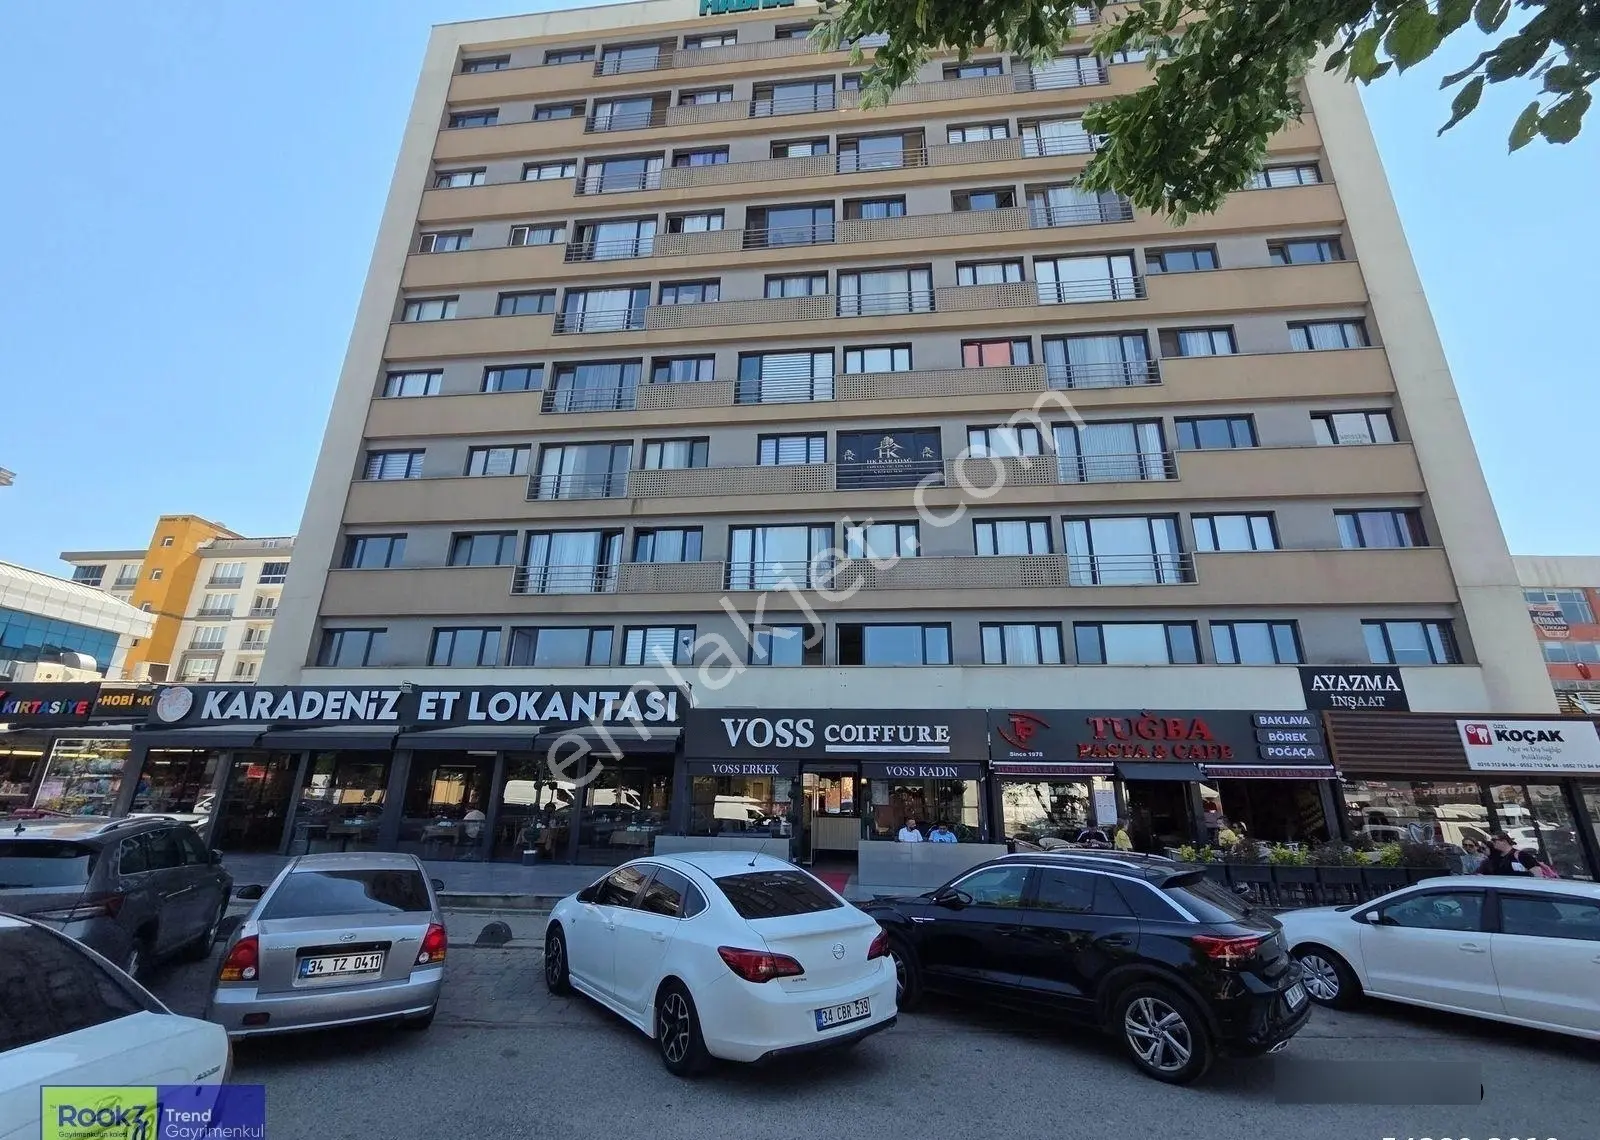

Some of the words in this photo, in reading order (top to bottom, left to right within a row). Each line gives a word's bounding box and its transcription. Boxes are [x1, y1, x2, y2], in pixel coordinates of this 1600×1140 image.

[1311, 674, 1401, 691] AYAZMA
[2, 699, 89, 715] KIRTASİYE
[102, 693, 134, 706] HOBİ
[417, 691, 460, 721] ET
[468, 691, 677, 722] LOKANTASI
[1330, 693, 1385, 710] İNŞAAT
[1087, 709, 1214, 740] TUĞBA
[1259, 716, 1311, 725] BAKLAVA
[720, 717, 815, 748] VOSS
[824, 724, 950, 743] COIFFURE
[1268, 730, 1308, 742] BÖREK
[1494, 729, 1565, 745] KOÇAK
[1077, 743, 1147, 759] PASTA
[1171, 743, 1235, 760] CAFE
[1267, 745, 1316, 759] POĞAÇA
[712, 763, 740, 775] VOSS
[742, 763, 780, 775] ERKEK
[886, 765, 915, 777] VOSS
[919, 765, 958, 778] KADIN
[308, 960, 324, 973] 34
[333, 958, 348, 971] TZ
[354, 955, 380, 968] 0411
[822, 1008, 834, 1023] 34
[836, 1004, 852, 1020] CBR
